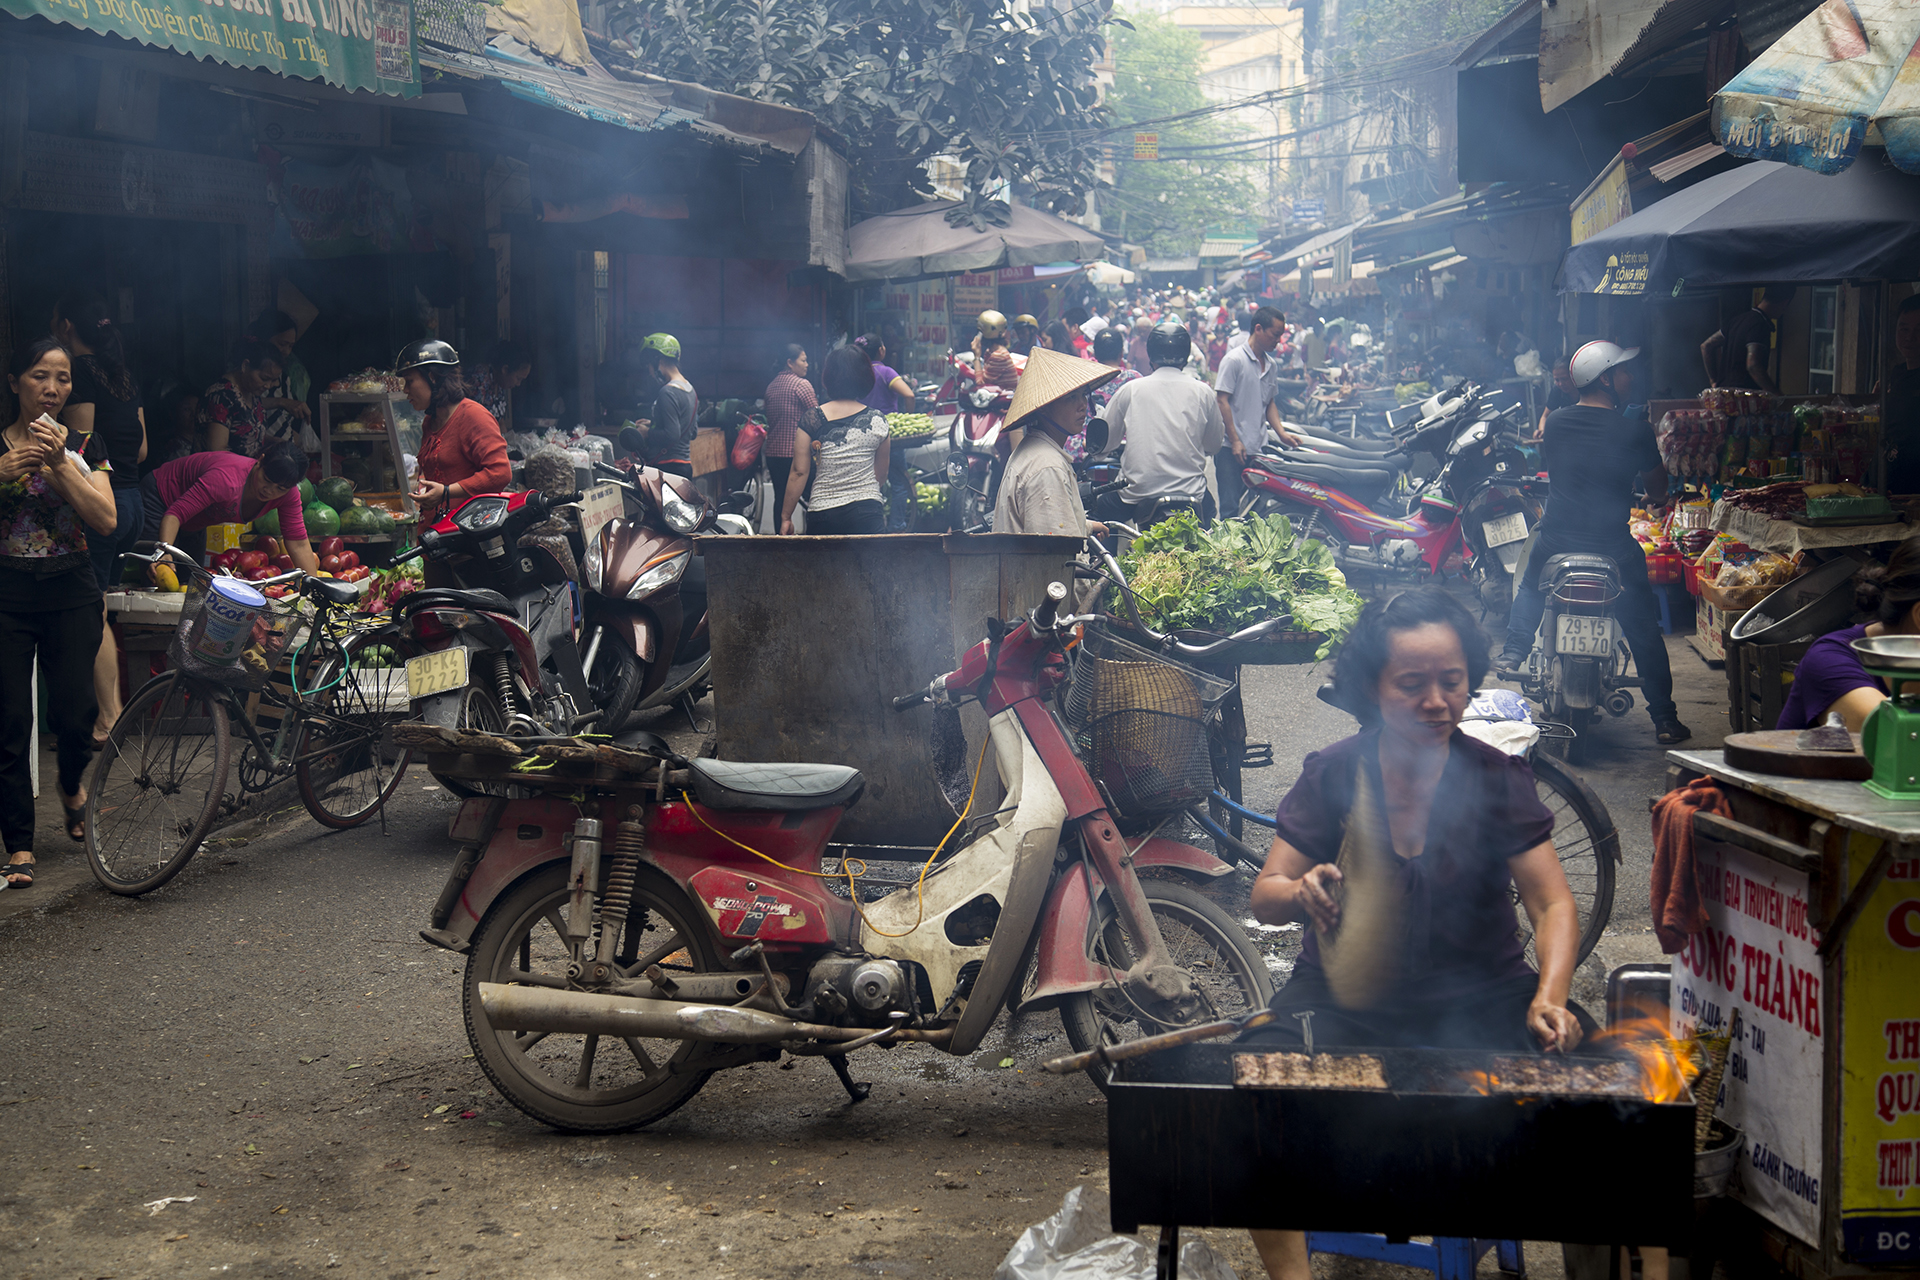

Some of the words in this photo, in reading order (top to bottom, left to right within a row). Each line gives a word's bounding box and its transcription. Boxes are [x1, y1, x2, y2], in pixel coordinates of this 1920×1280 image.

[1565, 618, 1606, 637] 29-Y5
[1561, 635, 1609, 655] 115.70
[415, 651, 458, 676] 30-K4
[415, 669, 460, 695] 7222
[1724, 870, 1741, 912] GIA
[746, 911, 764, 919] 70
[1741, 940, 1821, 1038] THÀNH
[1752, 1024, 1766, 1055] TAI
